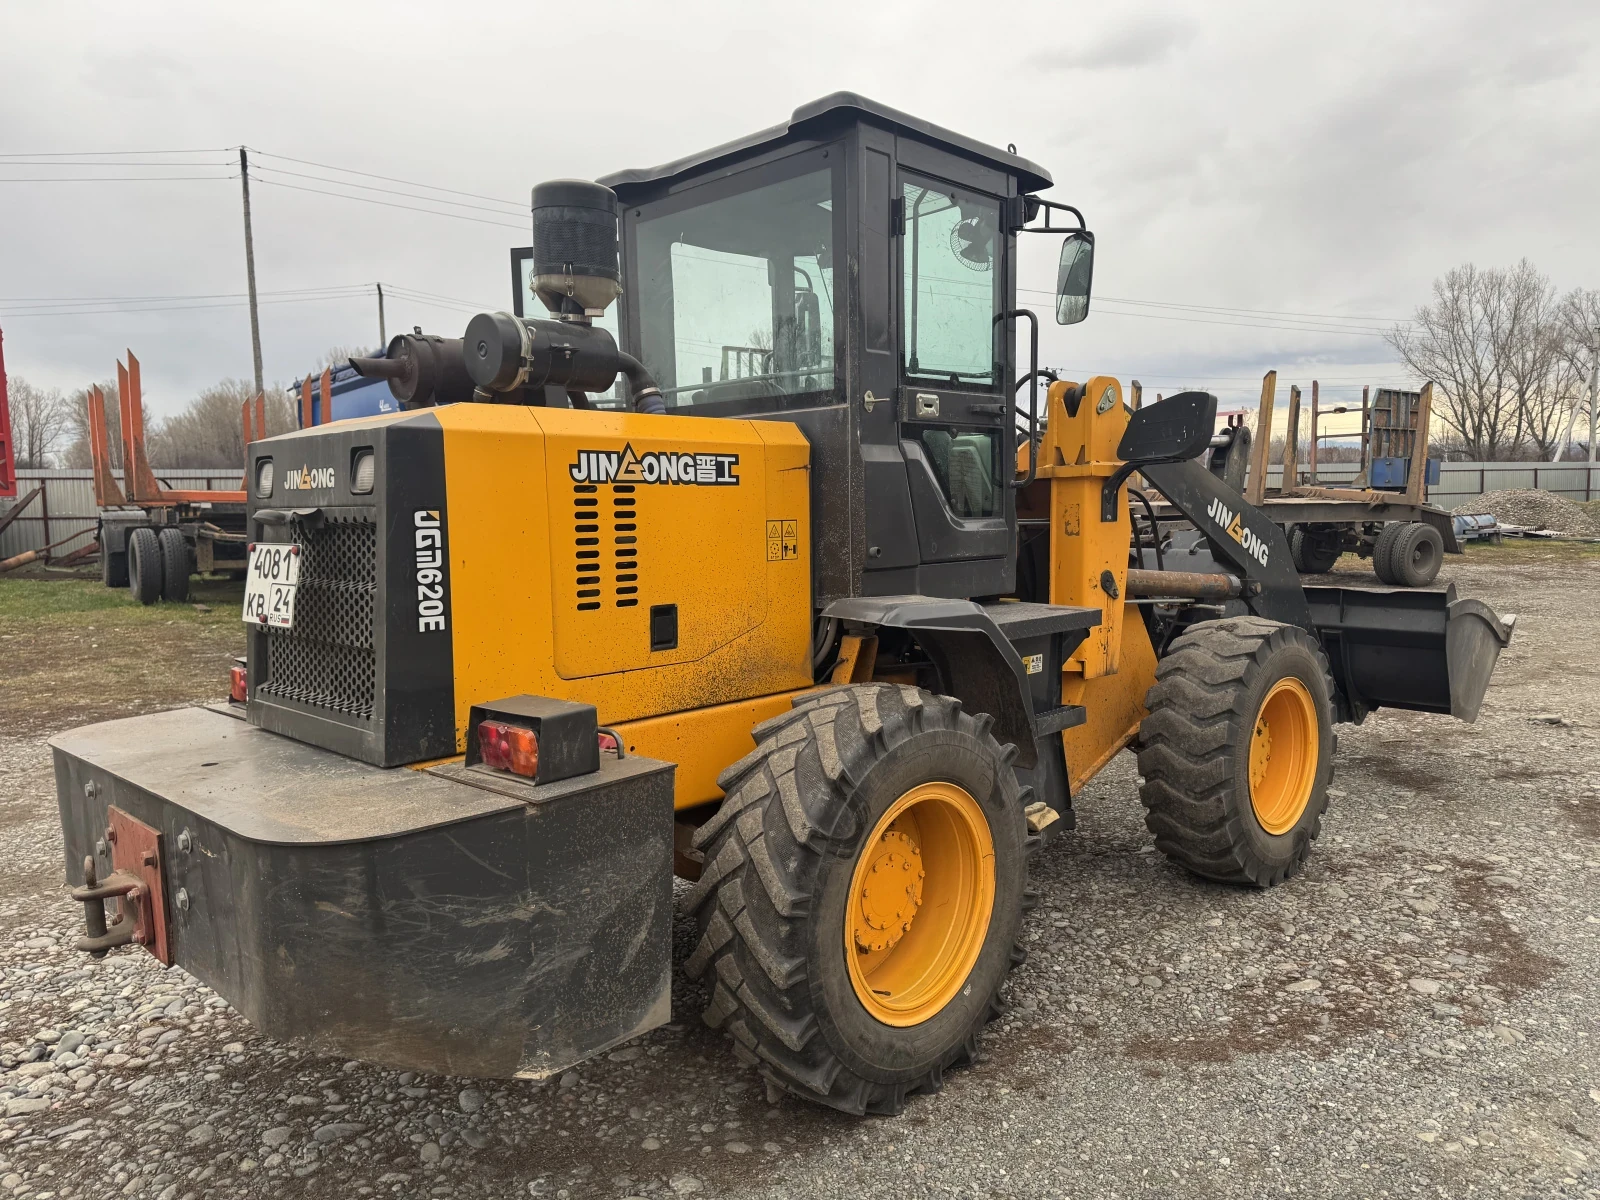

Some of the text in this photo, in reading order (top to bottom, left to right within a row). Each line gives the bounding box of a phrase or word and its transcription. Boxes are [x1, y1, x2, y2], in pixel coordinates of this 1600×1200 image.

[284, 463, 335, 490] JINGONG
[1207, 497, 1269, 568] JINGONG
[254, 548, 292, 581] 4081
[273, 588, 291, 613] 24
[269, 613, 281, 623] RUS
